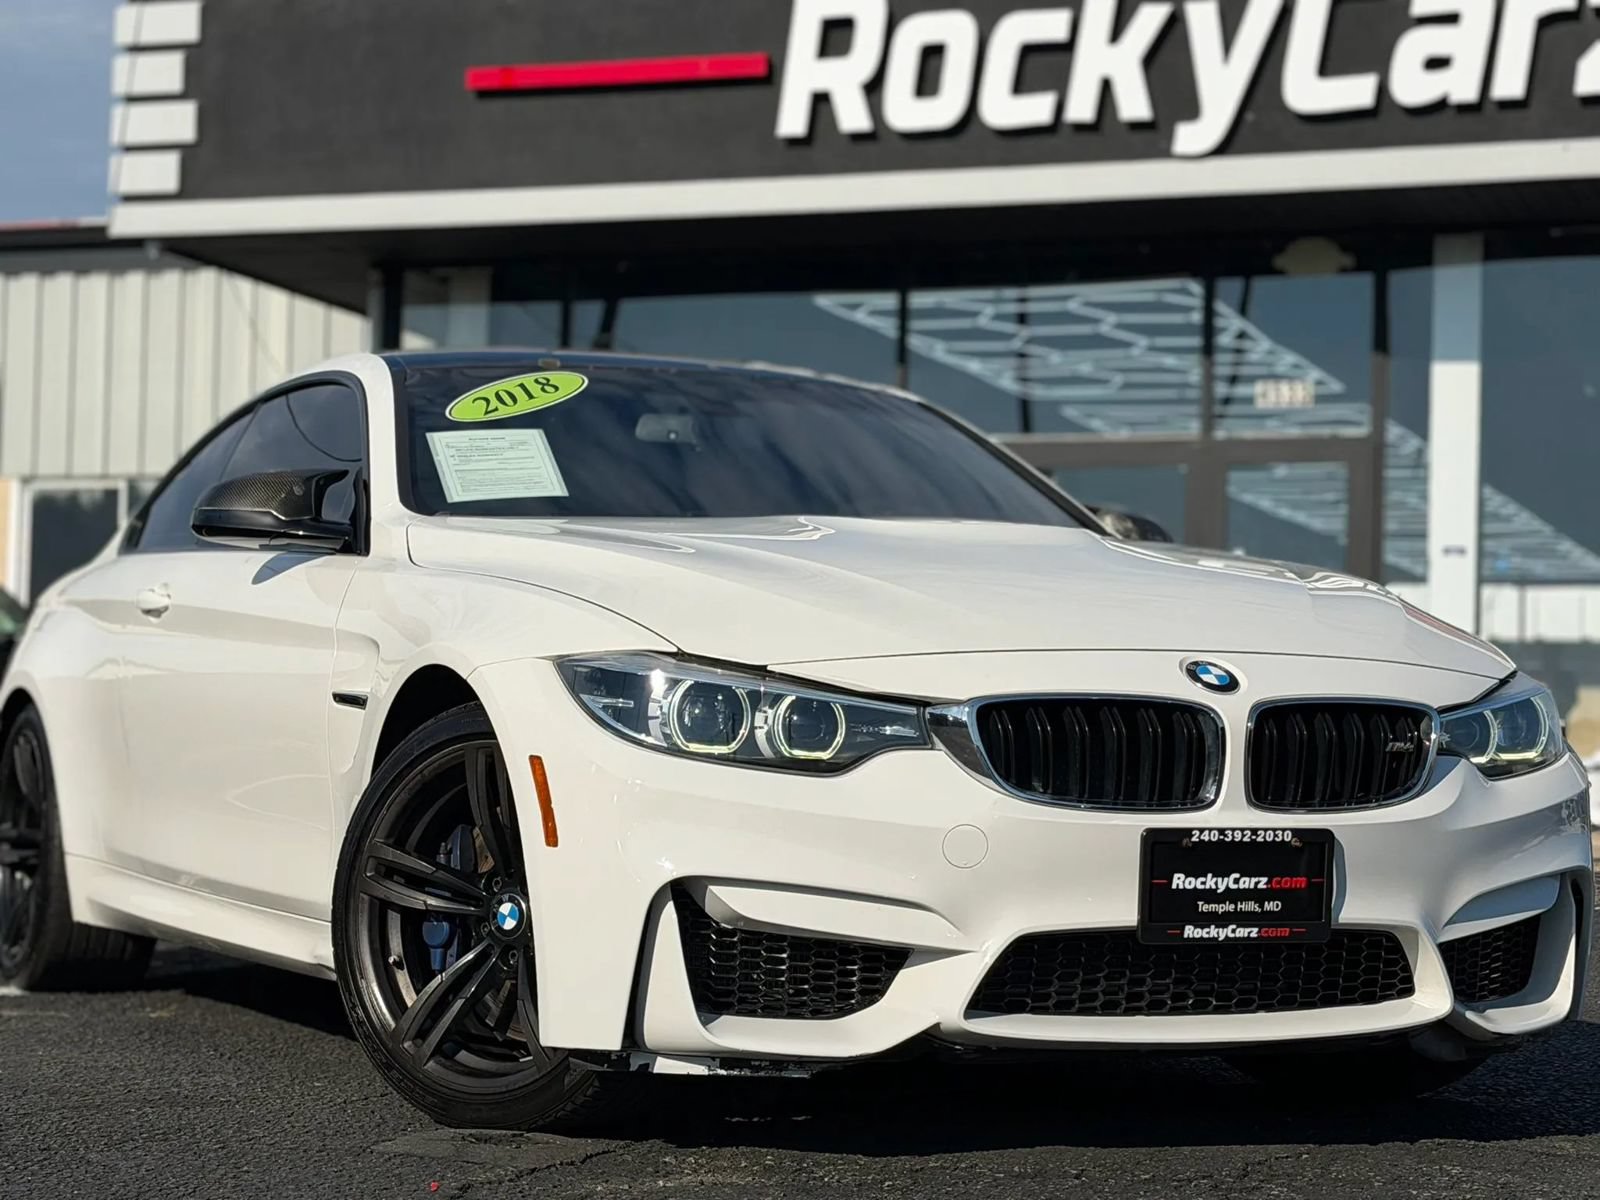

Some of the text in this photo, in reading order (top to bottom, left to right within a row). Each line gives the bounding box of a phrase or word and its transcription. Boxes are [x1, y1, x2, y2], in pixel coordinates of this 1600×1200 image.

[471, 376, 560, 417] 2018
[1190, 829, 1293, 842] 240-392-2030
[1171, 872, 1309, 894] RockyCarz.com
[1197, 900, 1282, 915] Temple Hills, MD
[1183, 924, 1291, 941] RockyCarz.com
